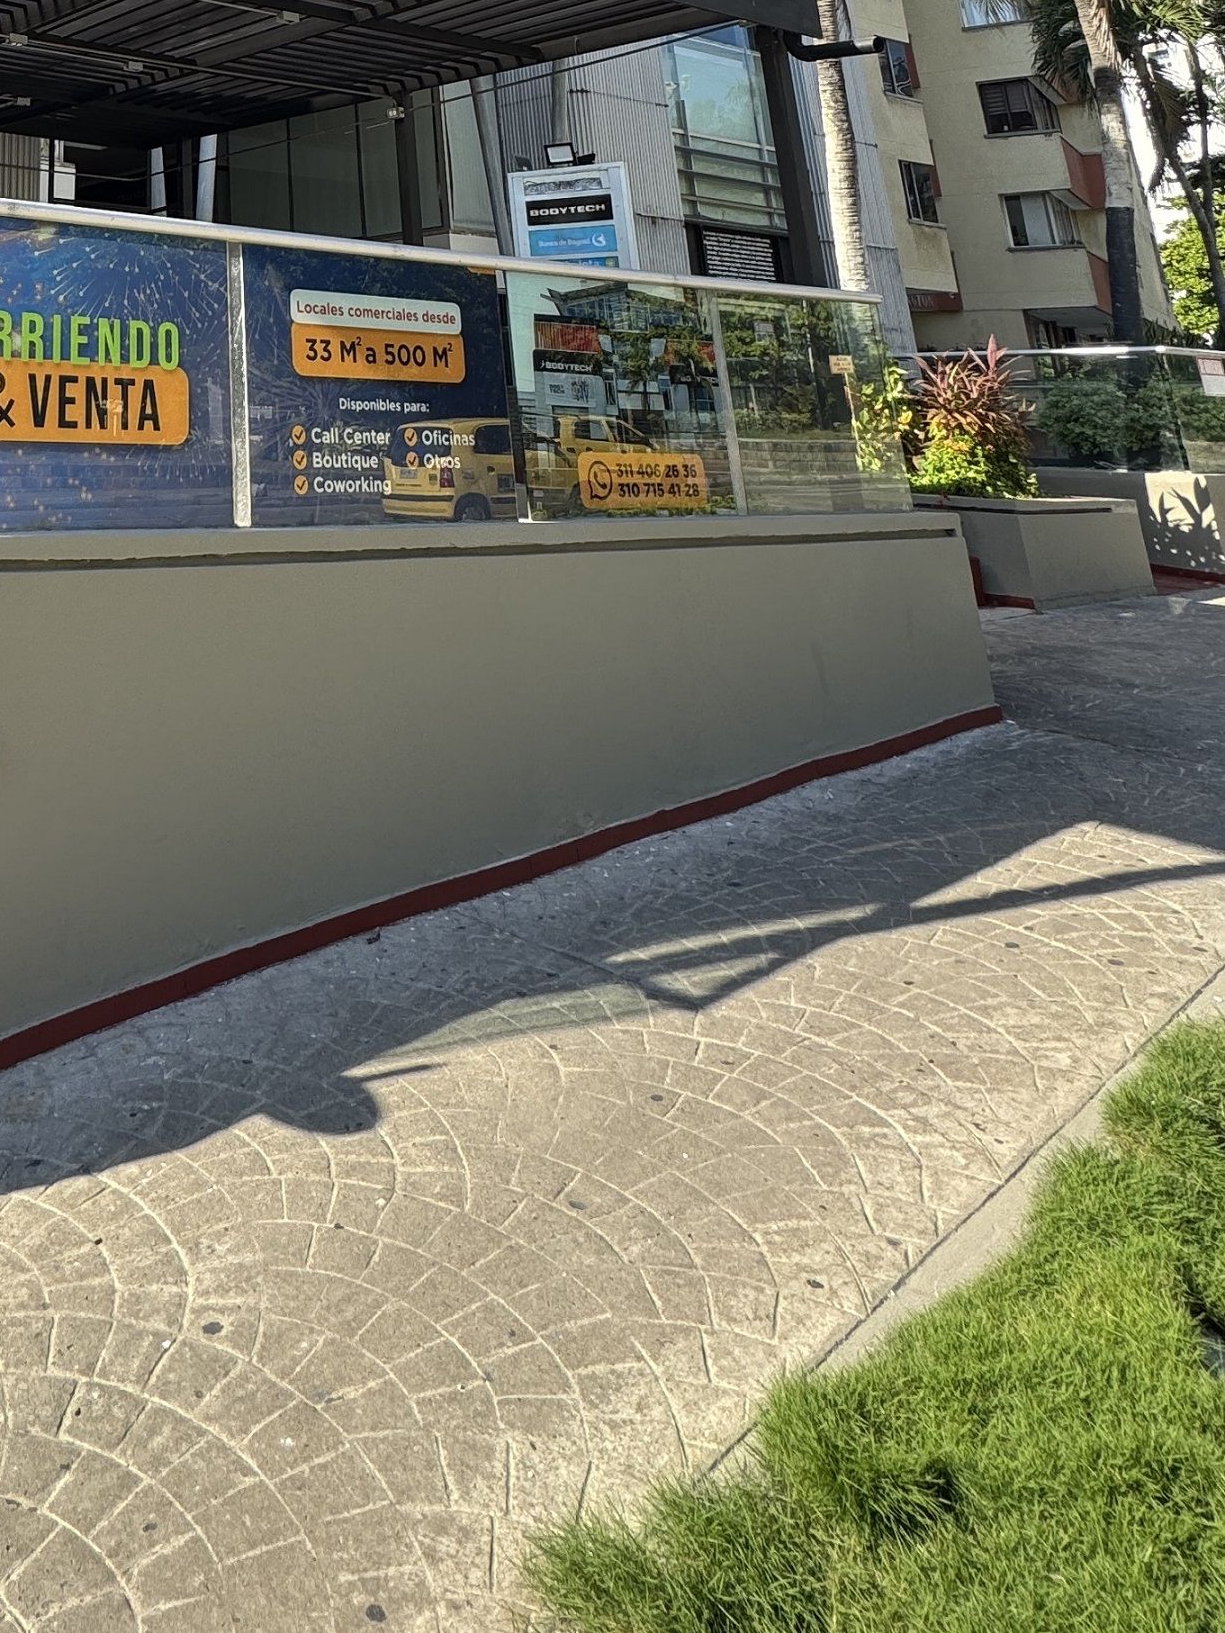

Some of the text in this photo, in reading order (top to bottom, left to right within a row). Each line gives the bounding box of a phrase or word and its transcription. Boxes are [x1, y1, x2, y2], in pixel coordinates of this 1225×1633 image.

[529, 203, 606, 217] BODYTECH
[296, 300, 456, 325] Locales comerciales desde
[305, 337, 332, 363] 33
[364, 347, 377, 365] a
[384, 342, 426, 368] 500
[27, 372, 162, 432] VENTA
[338, 397, 430, 414] Disponibles para:
[310, 427, 391, 446] Call Center
[421, 429, 476, 447] Oficinas
[312, 451, 379, 470] Boutique
[423, 452, 461, 469] Otros
[615, 462, 634, 478] 311
[635, 463, 662, 479] 406
[682, 463, 697, 478] 36
[313, 475, 392, 495] Coworking
[618, 482, 700, 498] 310 715 41 28
